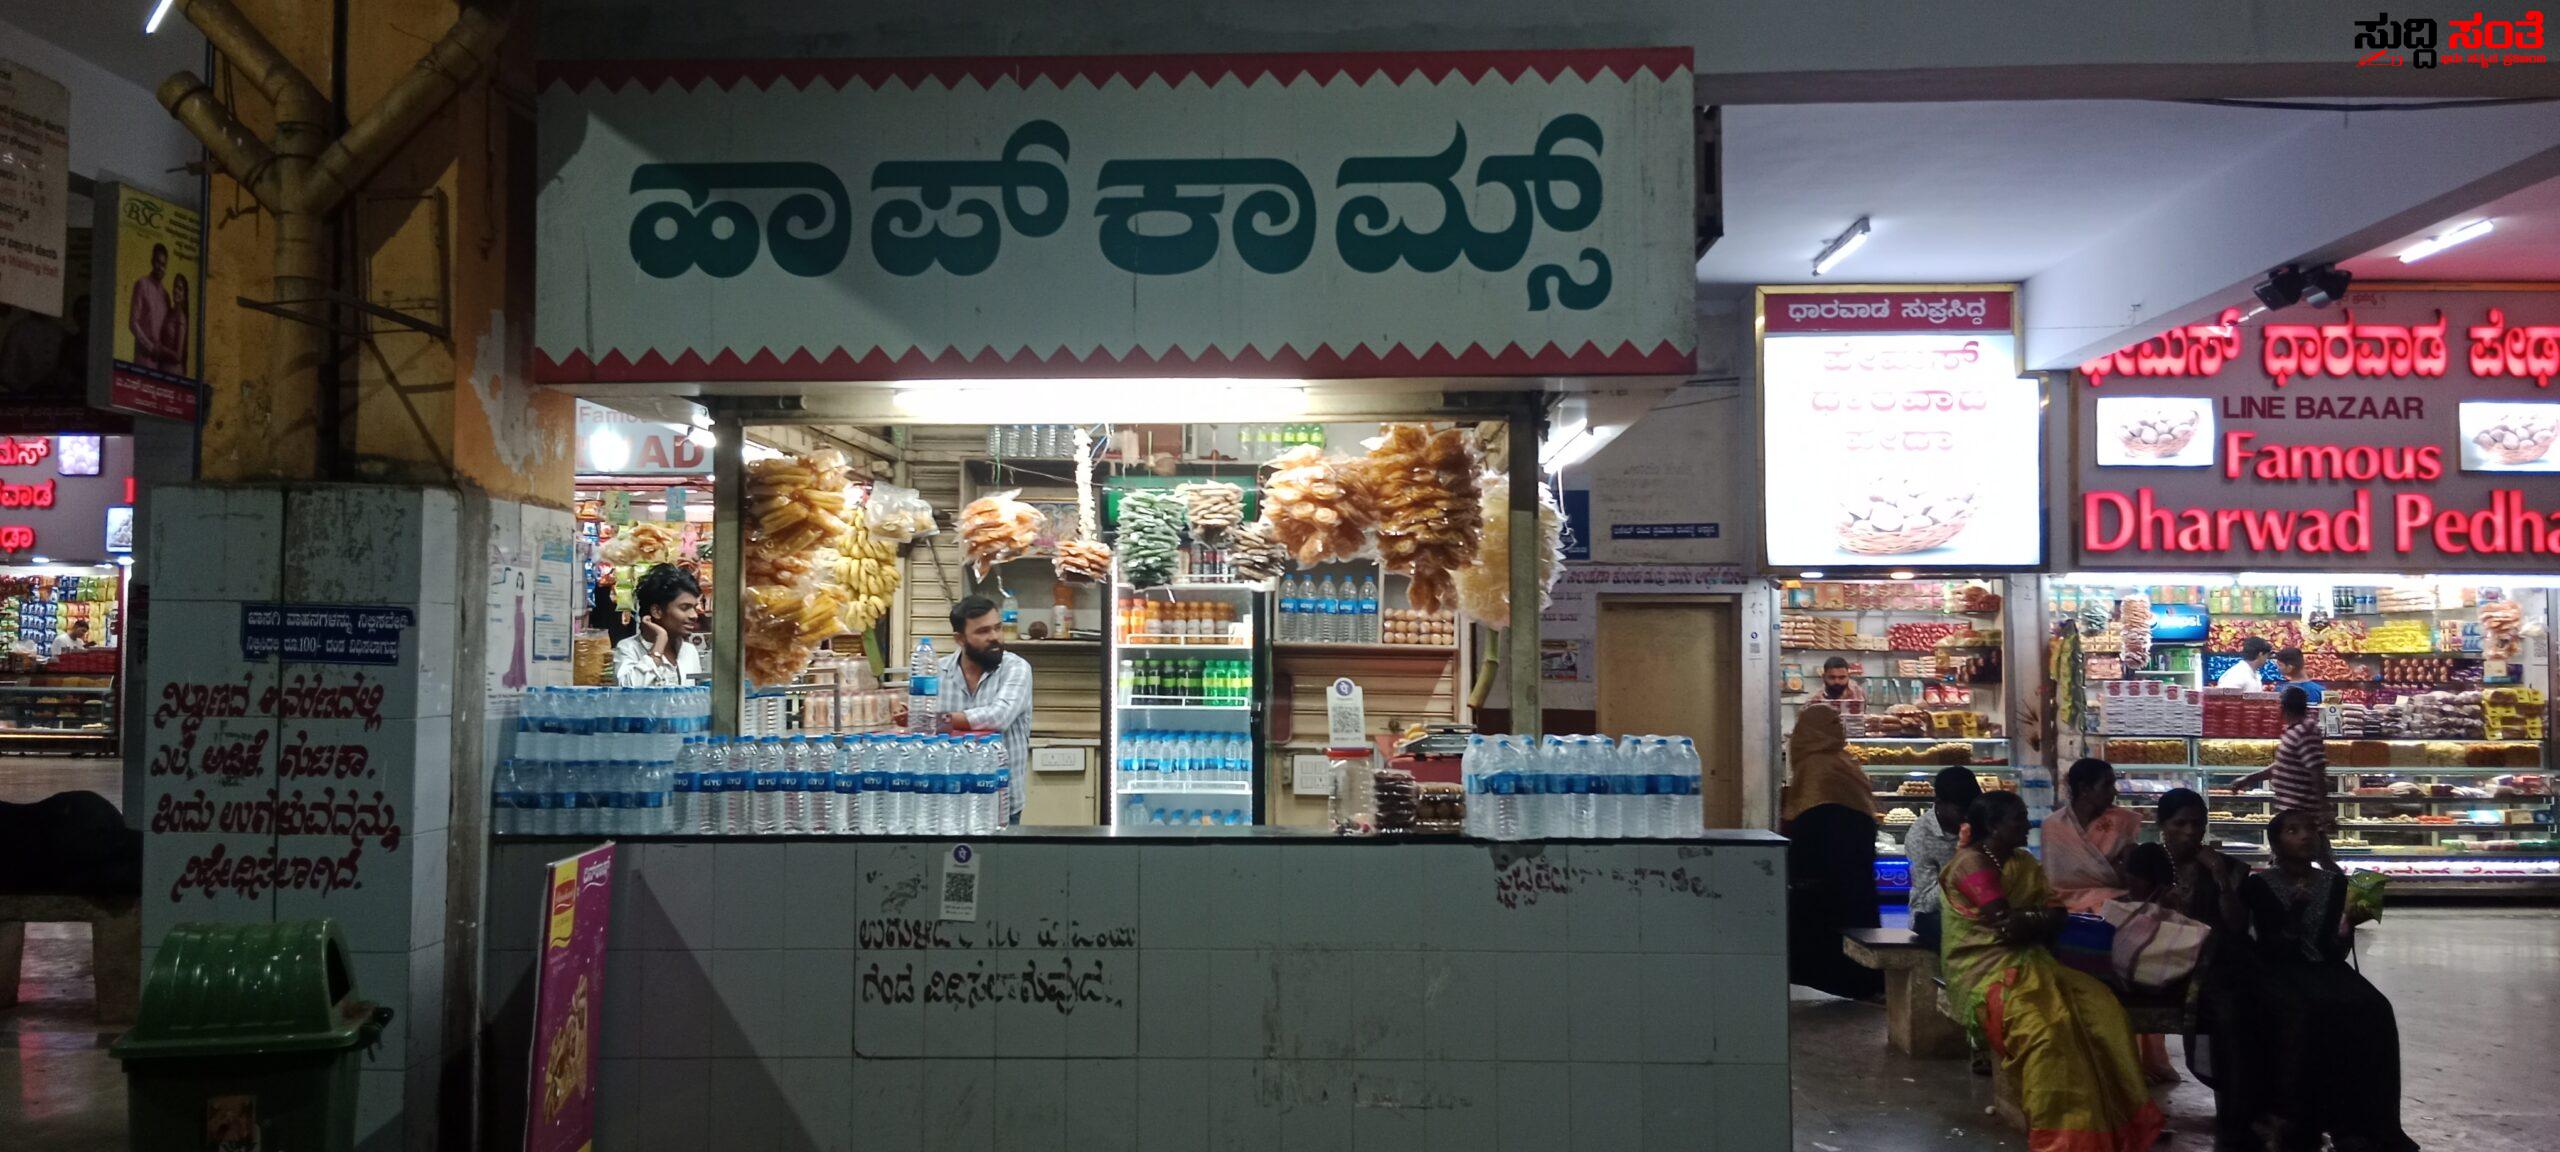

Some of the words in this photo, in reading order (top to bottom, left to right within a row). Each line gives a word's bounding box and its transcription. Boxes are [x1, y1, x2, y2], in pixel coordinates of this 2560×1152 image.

[1788, 299, 1891, 323] ಧಾರವಾಡ
[2262, 306, 2448, 387] ಧಾರವಾಡ
[2223, 398, 2287, 419] LINE
[2296, 397, 2425, 420] BAZAAR
[2223, 431, 2443, 481] Famous
[0, 479, 55, 509] ವಾಡ
[2083, 486, 2373, 554] Dharwad
[152, 788, 216, 834] ತಿಂದು
